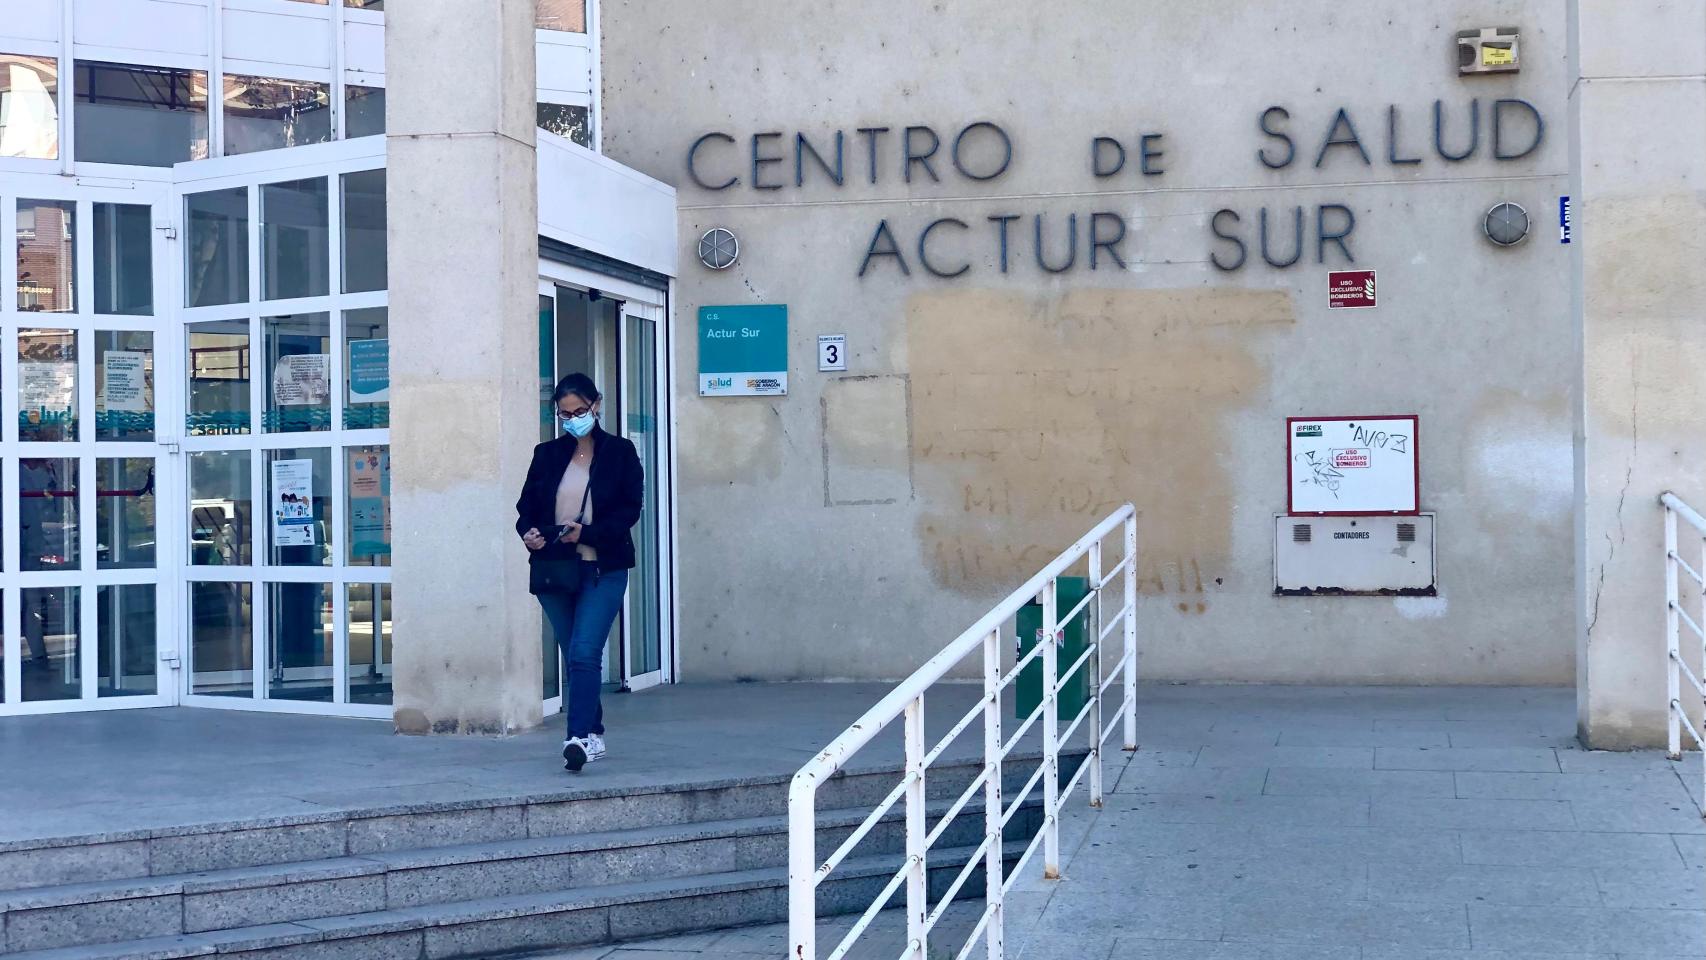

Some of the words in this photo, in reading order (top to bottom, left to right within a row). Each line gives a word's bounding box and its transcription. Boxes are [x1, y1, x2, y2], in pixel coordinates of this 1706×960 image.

[687, 120, 1012, 191] CENTRO
[1093, 133, 1165, 177] DE
[1258, 98, 1545, 169] SALUD
[858, 212, 1128, 278] ACTUR
[1210, 204, 1355, 271] SUR
[707, 328, 737, 338] Actur
[741, 327, 760, 338] Sur
[826, 344, 838, 364] 3
[707, 377, 732, 389] salud
[18, 405, 72, 424] salud
[1333, 531, 1370, 540] CONTADORES
